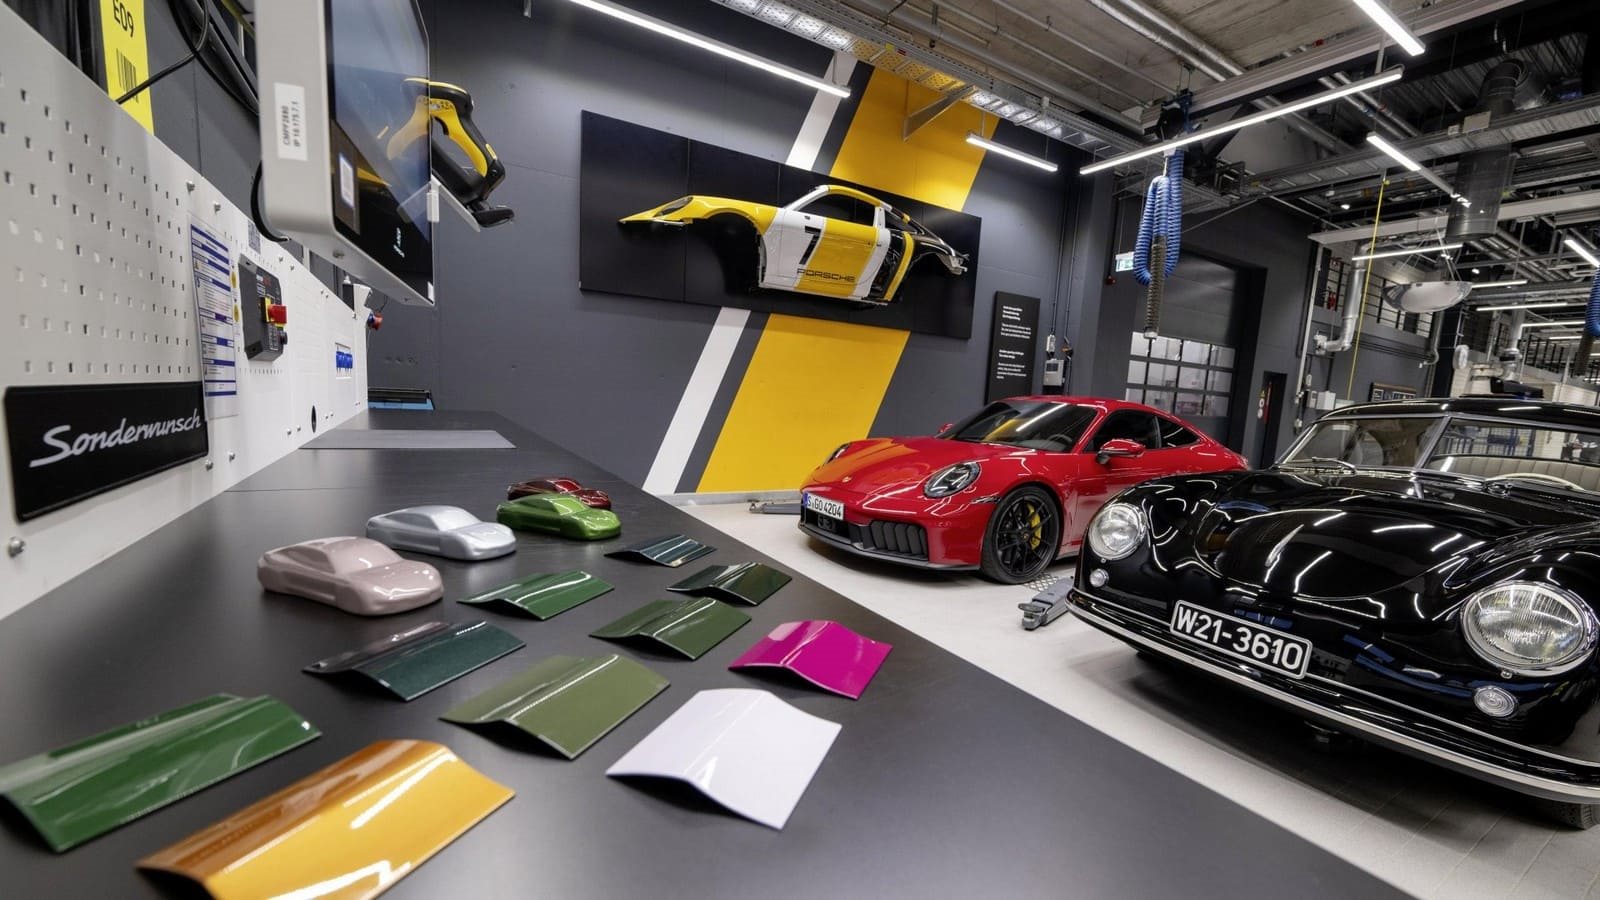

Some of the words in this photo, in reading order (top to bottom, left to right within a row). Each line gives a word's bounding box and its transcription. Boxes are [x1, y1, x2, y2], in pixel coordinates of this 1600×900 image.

[112, 0, 134, 38] E09
[799, 225, 822, 265] 7
[797, 268, 856, 282] PORSCHE
[29, 408, 202, 468] Sonderwunsch
[824, 502, 842, 518] 4204
[1177, 606, 1304, 670] W21-3610
